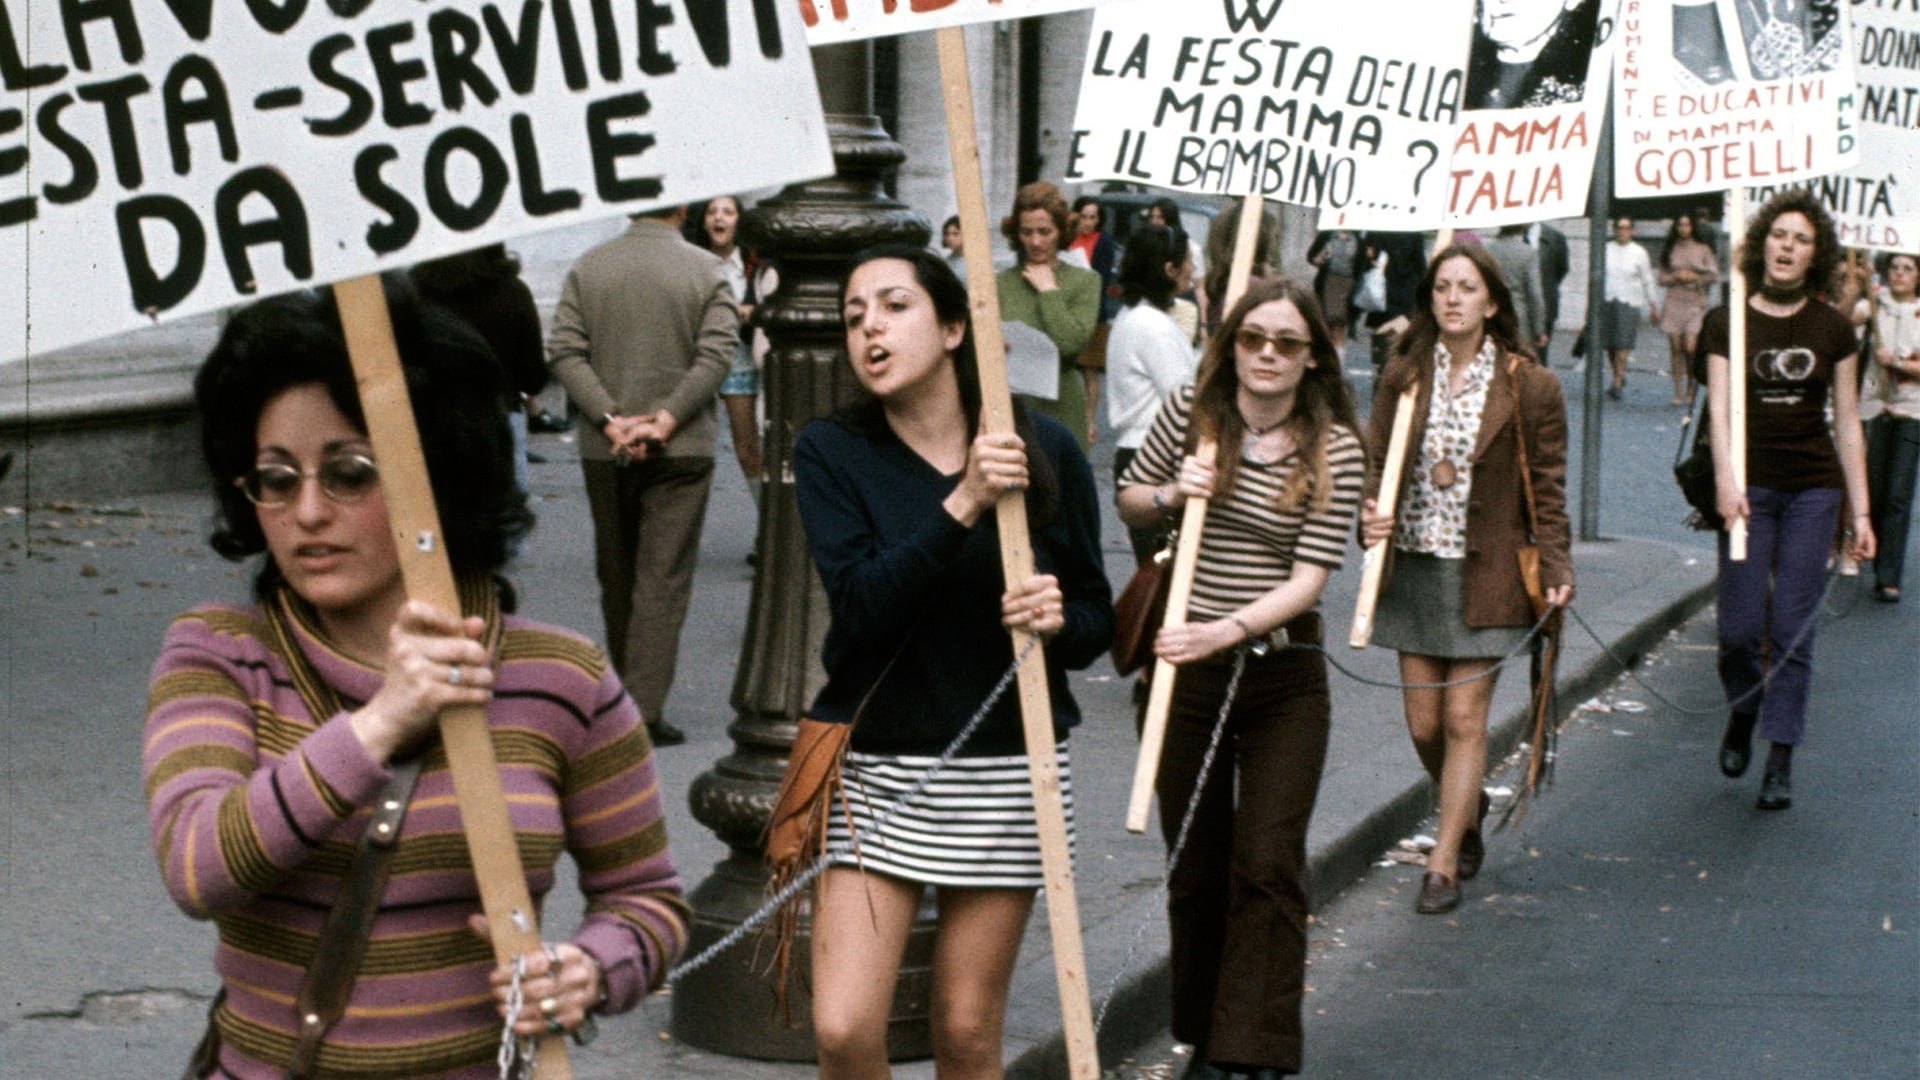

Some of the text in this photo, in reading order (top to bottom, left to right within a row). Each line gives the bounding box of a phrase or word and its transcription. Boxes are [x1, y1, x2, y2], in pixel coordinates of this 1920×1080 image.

[1092, 30, 1463, 126] LA FESTA DELLA
[1653, 79, 1825, 118] EDUCATIVI
[1153, 86, 1383, 156] MAMMA
[1633, 119, 1775, 145] DI MAMMA
[1066, 130, 1091, 178] E
[1113, 129, 1151, 179] IL
[1635, 134, 1812, 190] GOTELLI
[115, 91, 664, 317] DA SOLE
